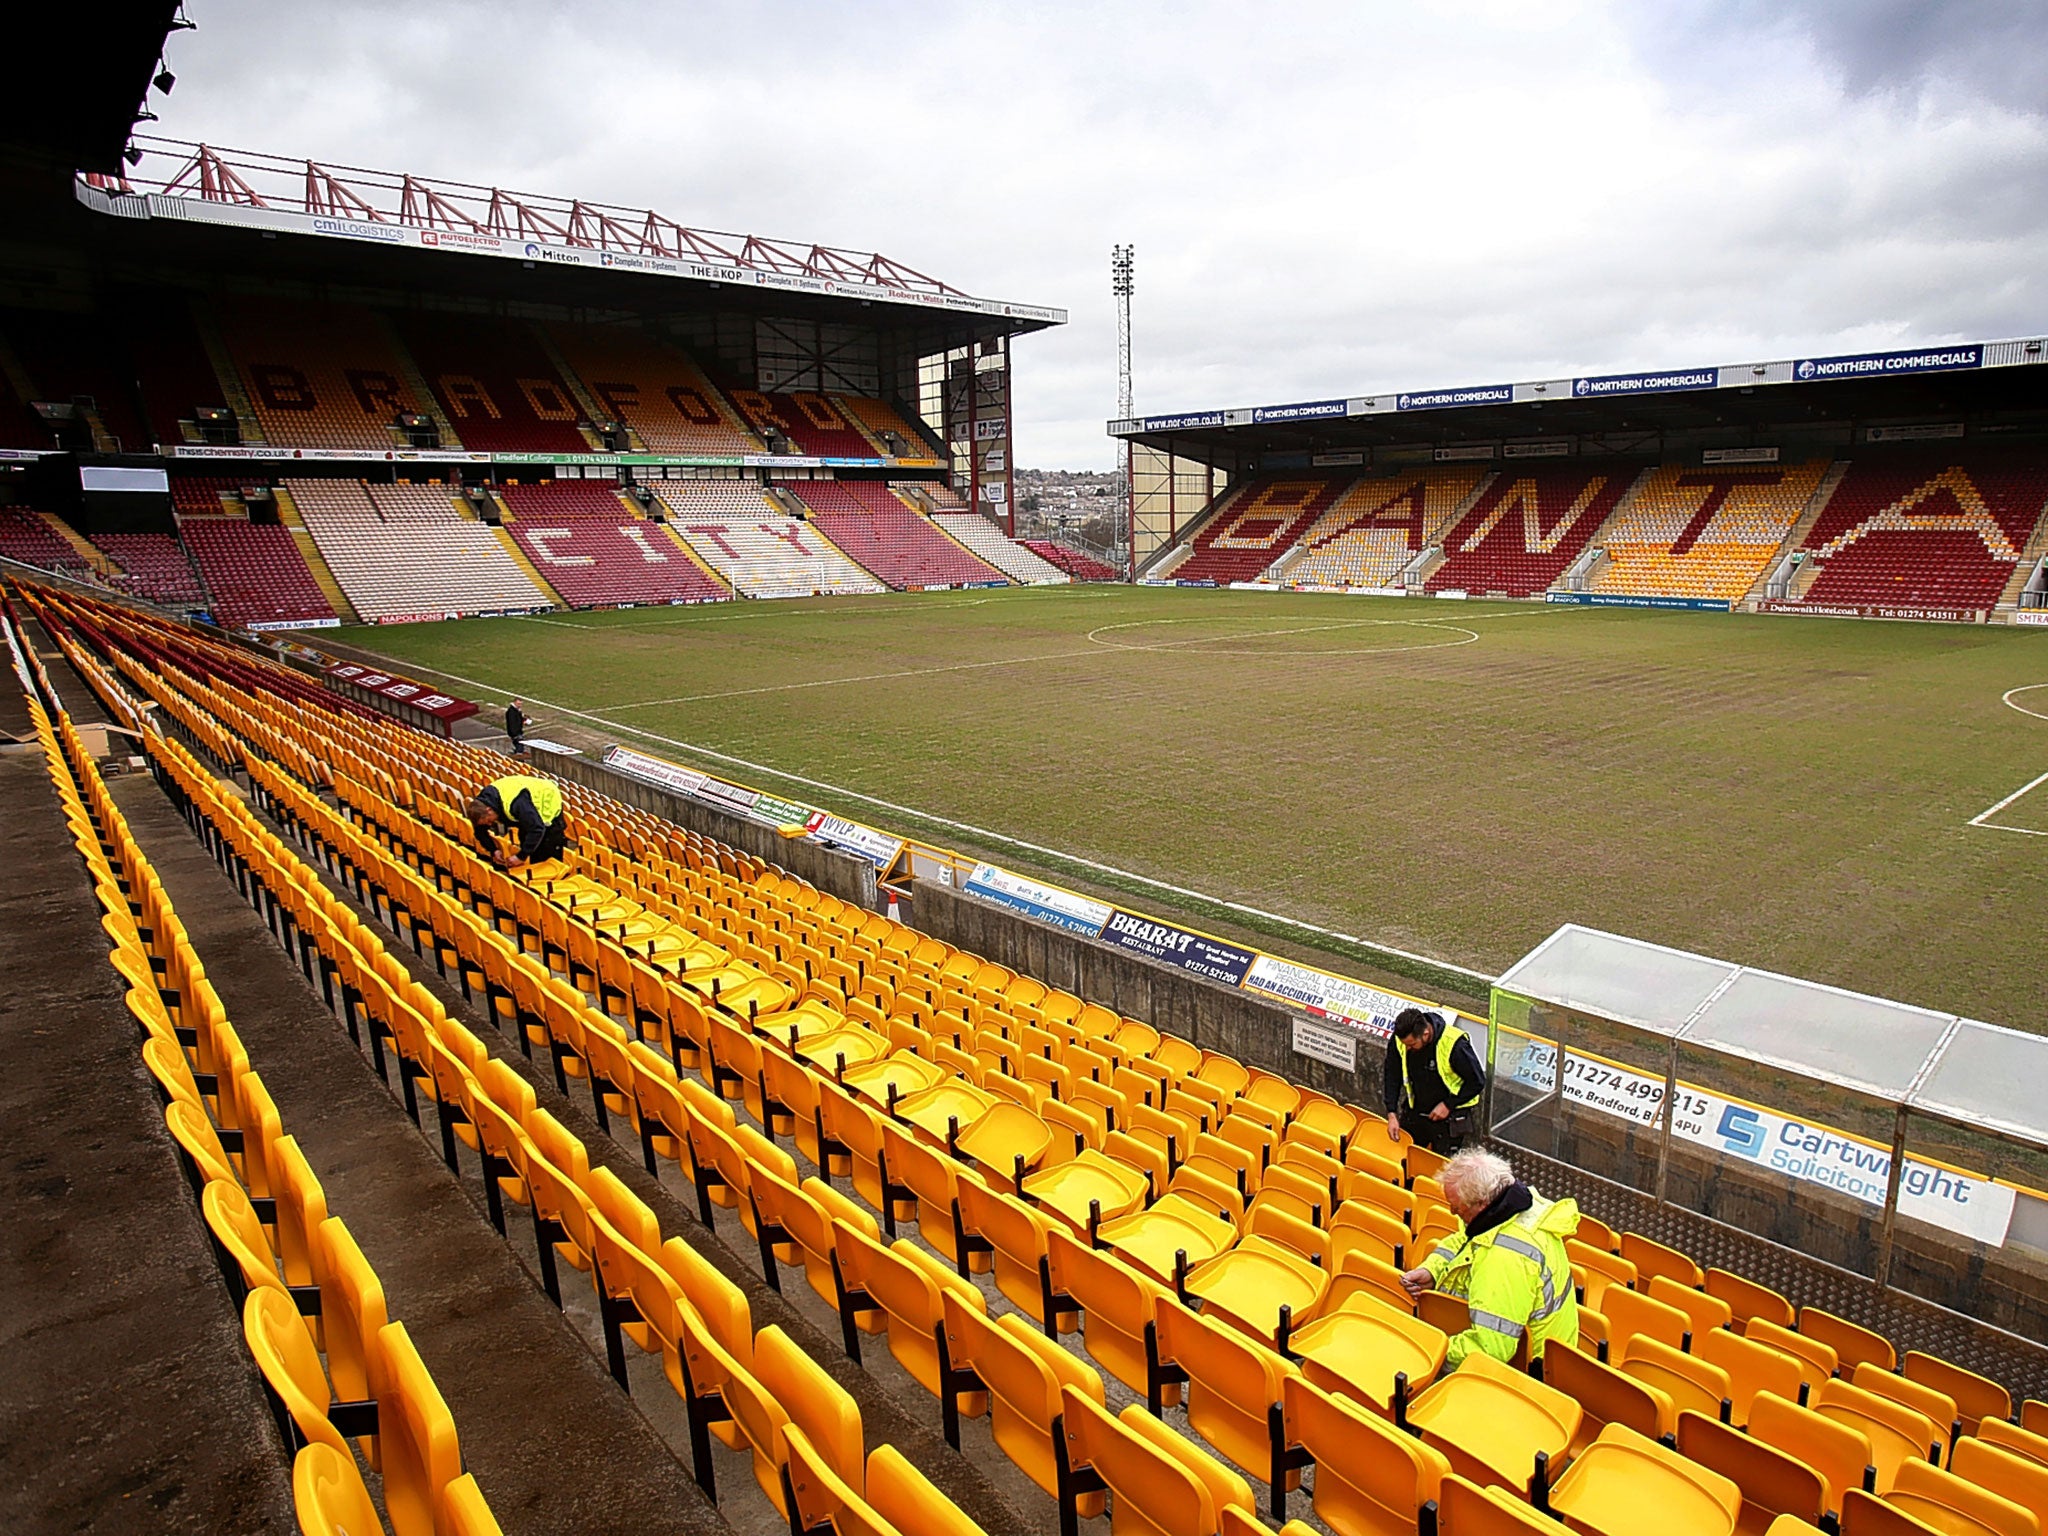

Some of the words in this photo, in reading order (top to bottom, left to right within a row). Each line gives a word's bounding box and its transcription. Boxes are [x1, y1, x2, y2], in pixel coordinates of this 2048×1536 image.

[440, 233, 500, 246] AUTOELECTRO
[543, 249, 580, 263] Mitton
[614, 256, 643, 268] Complete
[644, 259, 650, 269] IT
[652, 261, 676, 272] Systems
[690, 265, 711, 277] THE
[721, 269, 742, 280] KOP
[767, 275, 791, 286] Complete
[799, 280, 821, 290] Systems
[888, 289, 920, 301] Robert
[922, 294, 944, 304] Watts
[1817, 357, 1883, 375] NORTHERN
[1885, 351, 1976, 370] COMMERCIALS
[1591, 379, 1642, 392] NORTHERN
[1644, 374, 1713, 388] COMMERCIALS
[1411, 394, 1452, 406] NORTHERN
[1454, 390, 1509, 402] COMMERCIALS
[1264, 408, 1298, 419] NORTHERN
[1299, 404, 1344, 416] COMMERCIALS
[1146, 412, 1222, 430] www.nor-com.co.uk
[496, 453, 528, 462] Bradford
[529, 454, 555, 464] College
[381, 613, 443, 623] NAPOLEONS
[1770, 603, 1859, 617] DubrovnikHotel.co.uk
[1879, 608, 1895, 618] Tel:
[1897, 609, 1924, 619] 01274
[1926, 610, 1957, 620] 543511
[293, 621, 315, 629] Argus
[823, 816, 856, 836] WYLP
[1108, 912, 1195, 954] BHARAT
[1121, 936, 1166, 957] RESTAURANT
[1205, 953, 1231, 966] Bradford
[1239, 955, 1249, 964] Rd
[1184, 959, 1208, 975] 01274
[1208, 966, 1238, 984] 521200
[1265, 959, 1321, 985] FINANCIAL
[1325, 977, 1369, 1000] CLAIMS
[1247, 974, 1264, 987] HAD
[1264, 979, 1276, 991] AN
[1276, 983, 1323, 1007] ACCIDENT?
[1325, 1000, 1347, 1014] CALL
[1348, 1007, 1370, 1021] NOW
[1371, 1015, 1387, 1027] NO
[1275, 973, 1320, 995] PERSONAL
[1322, 988, 1357, 1005] INJURY
[1357, 997, 1397, 1019] SPECIAL
[1527, 1044, 1557, 1071] Tel:
[1563, 1058, 1622, 1091] 01274
[1624, 1080, 1666, 1104] 499
[1671, 1090, 1709, 1116] 215
[1517, 1066, 1531, 1079] 19
[1531, 1071, 1555, 1087] Oak
[1561, 1083, 1584, 1099] ane,
[1585, 1090, 1641, 1121] Bradford,
[1674, 1119, 1702, 1135] 4PU
[1779, 1121, 1971, 1204] Cartwight
[1770, 1148, 1887, 1203] Solicitors
